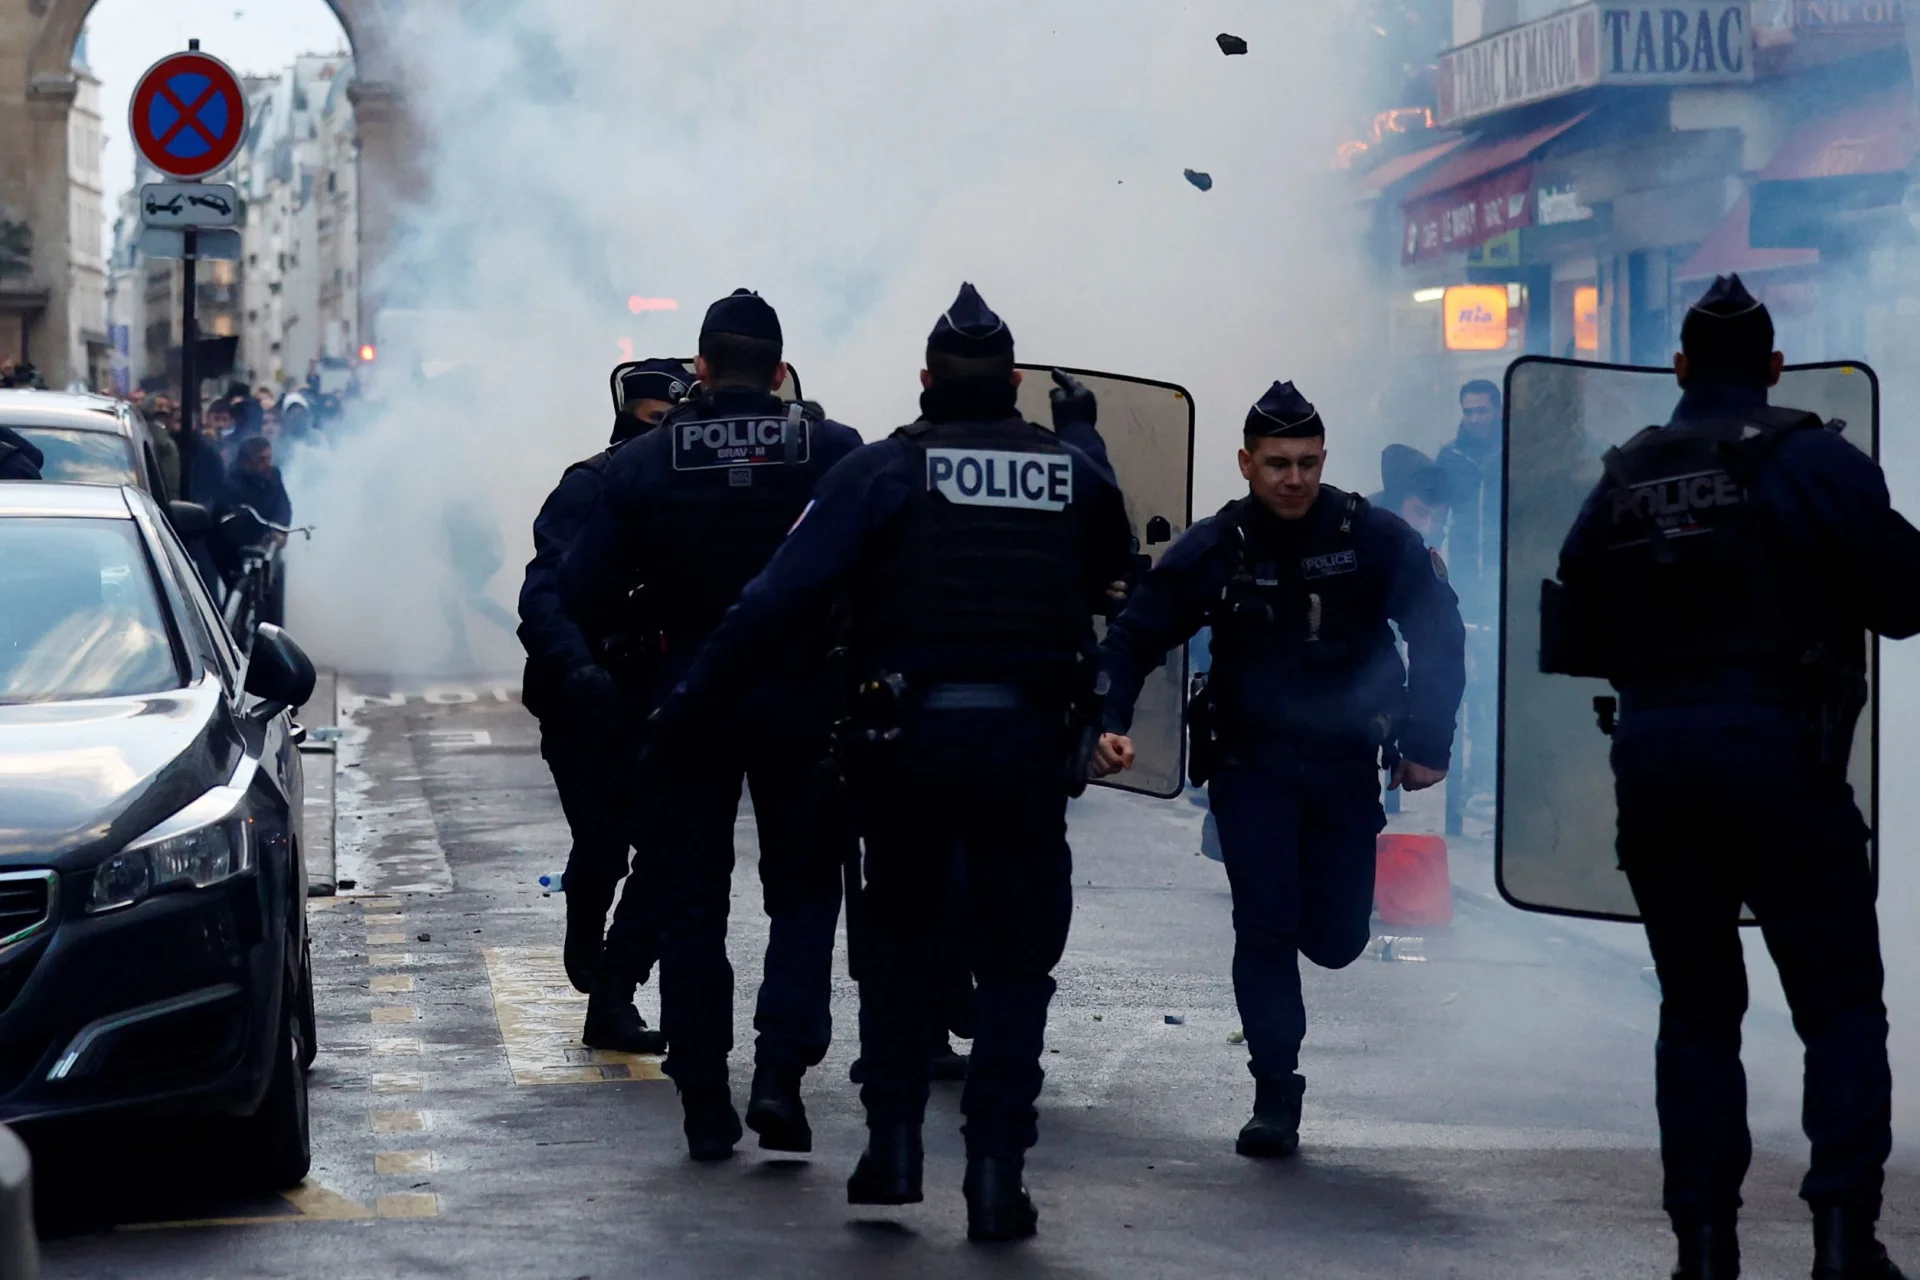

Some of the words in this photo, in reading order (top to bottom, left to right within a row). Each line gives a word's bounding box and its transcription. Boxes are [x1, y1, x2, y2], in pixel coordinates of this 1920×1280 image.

[1603, 6, 1743, 74] TABAC
[929, 456, 1069, 503] POLICE
[1306, 552, 1354, 570] POLICE
